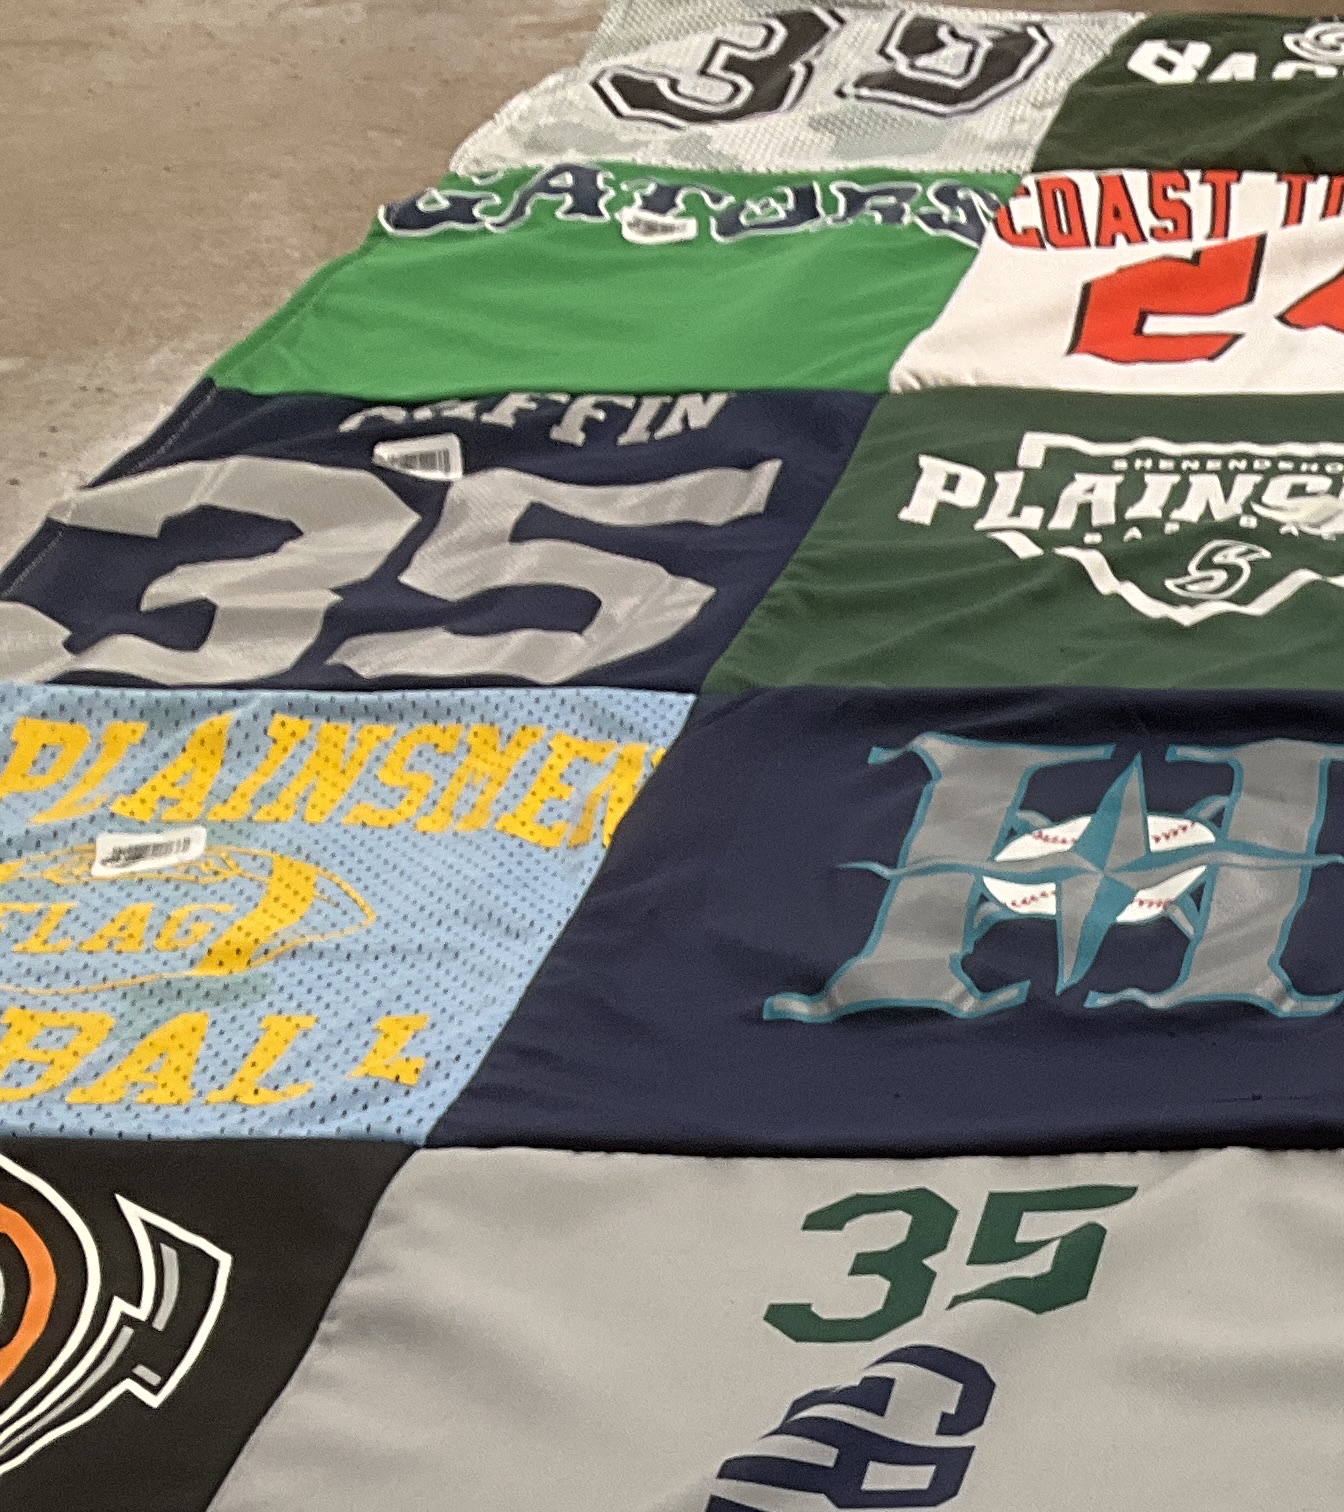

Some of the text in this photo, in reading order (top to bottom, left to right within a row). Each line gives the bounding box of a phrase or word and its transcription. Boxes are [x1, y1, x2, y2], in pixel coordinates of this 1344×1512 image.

[1000, 168, 1242, 249] COAST
[0, 455, 782, 686] 35
[762, 1184, 1139, 1343] 35
